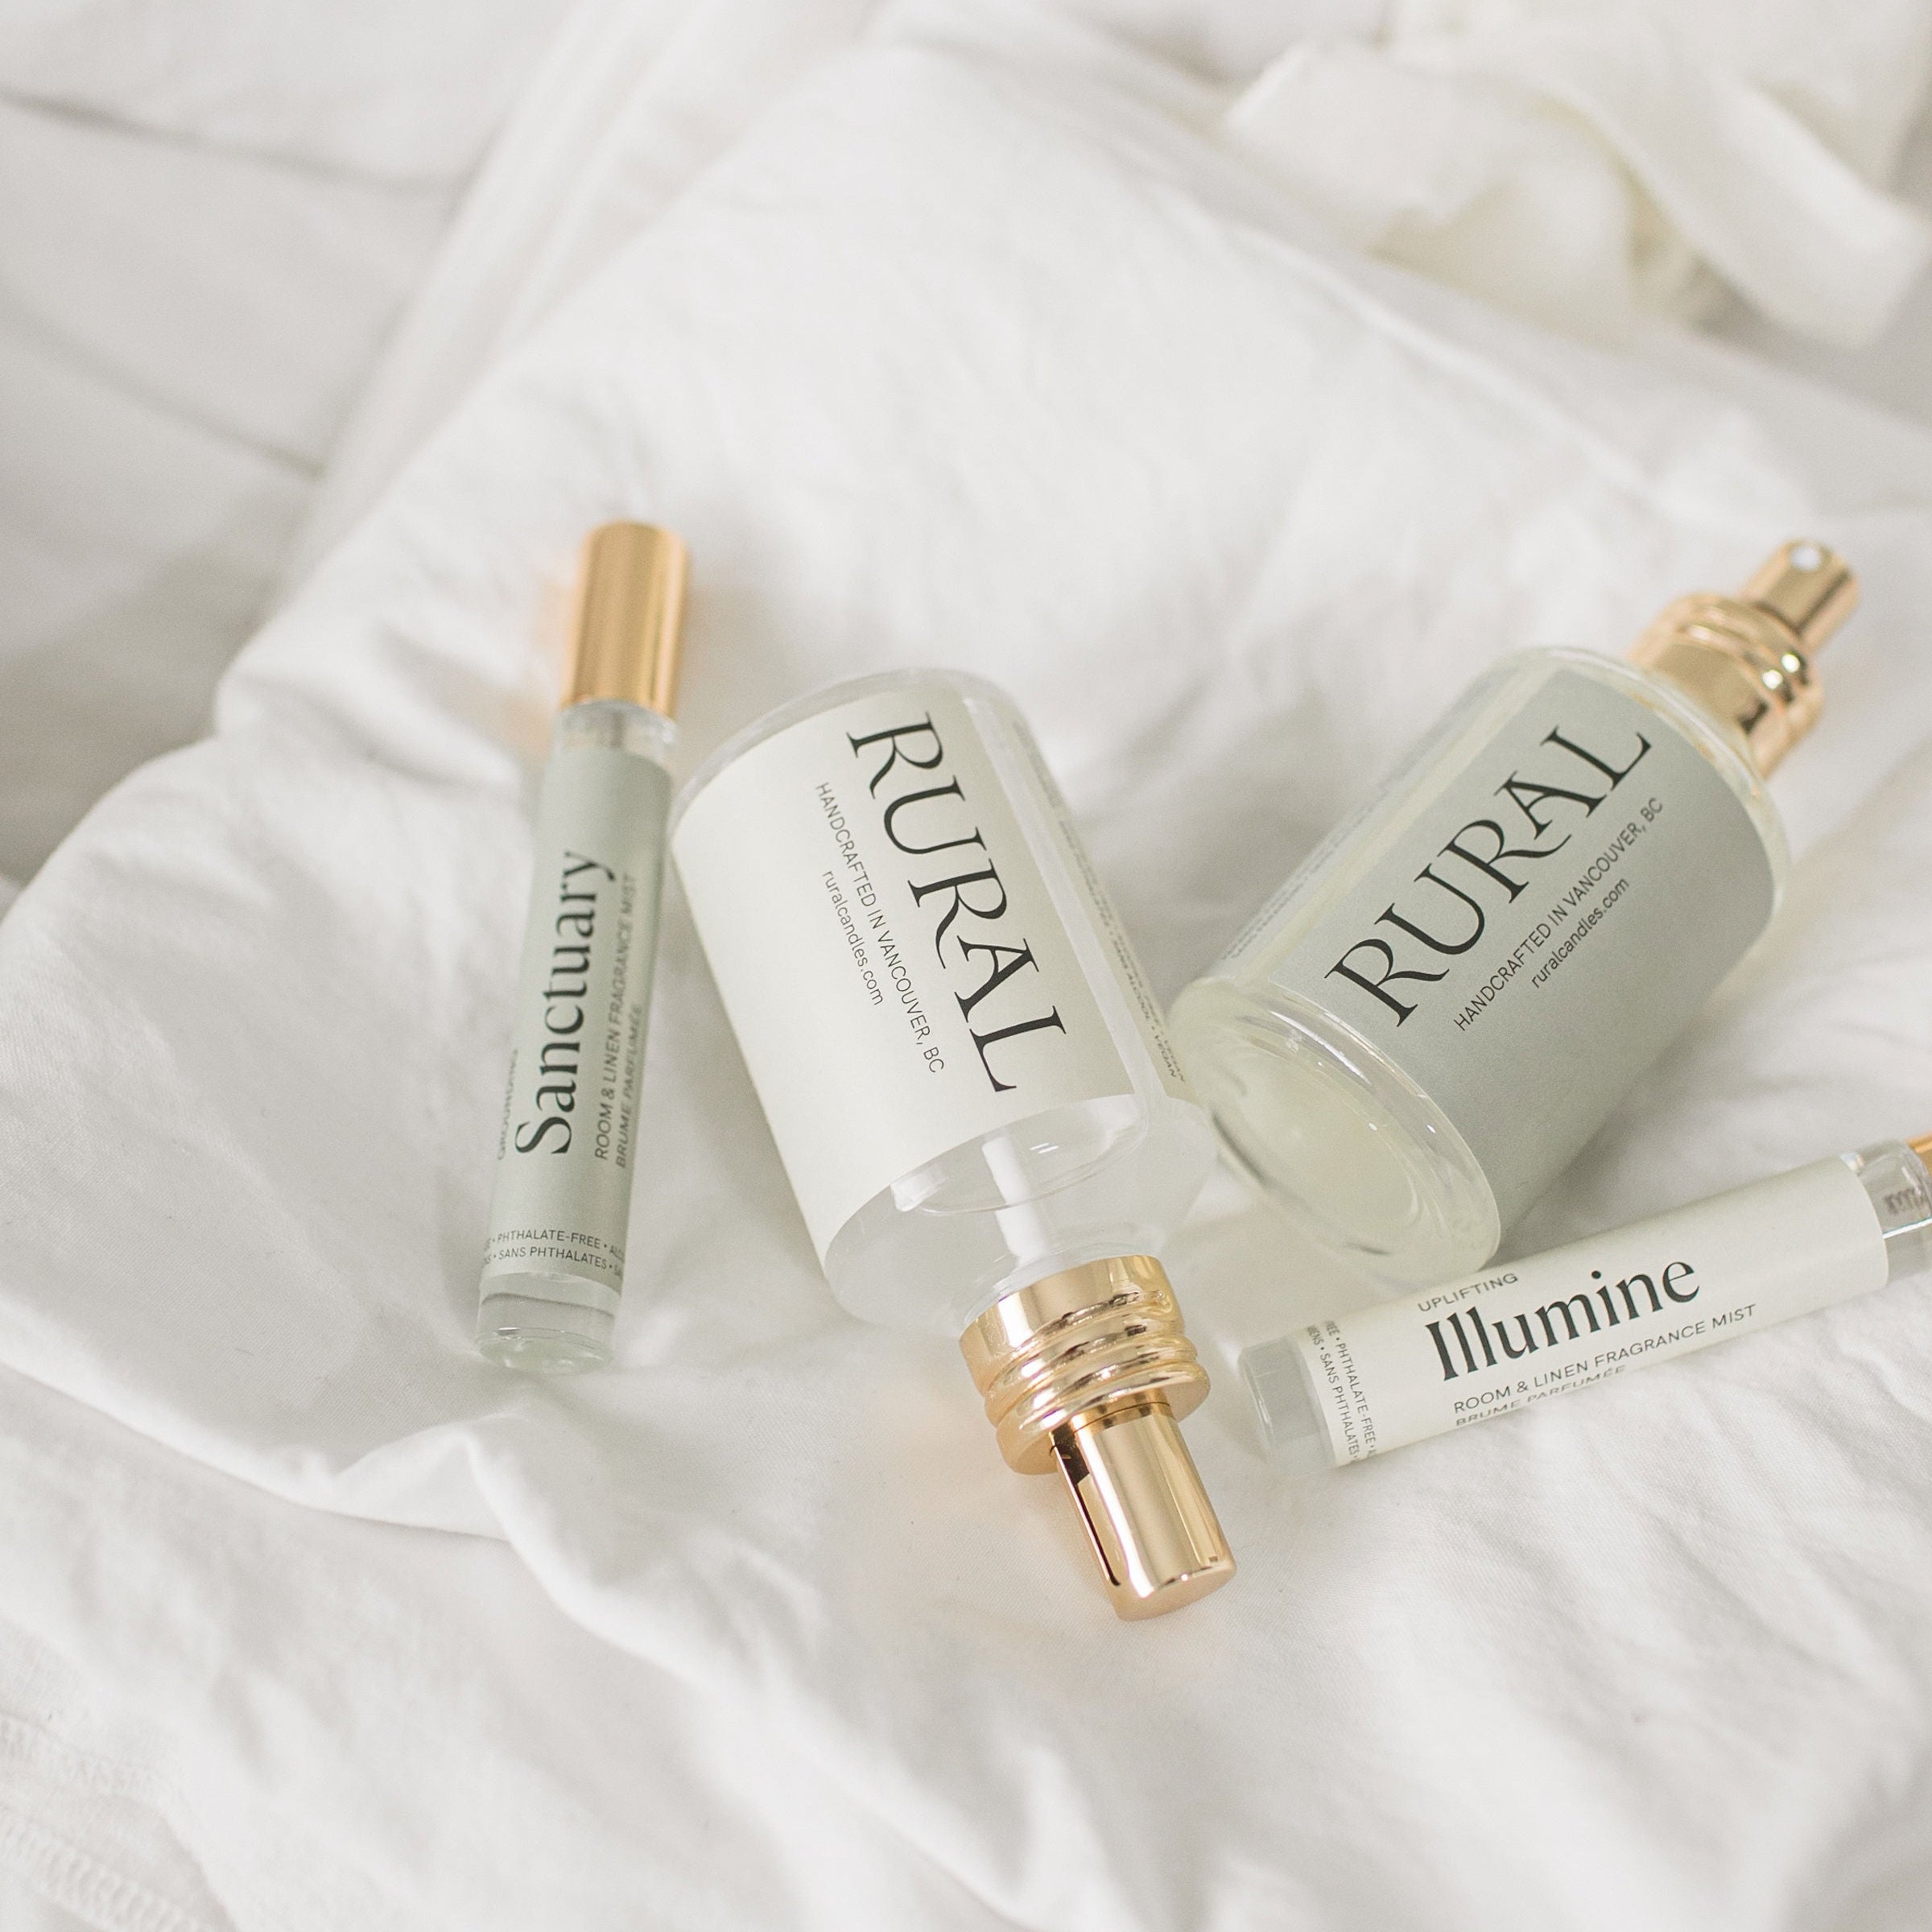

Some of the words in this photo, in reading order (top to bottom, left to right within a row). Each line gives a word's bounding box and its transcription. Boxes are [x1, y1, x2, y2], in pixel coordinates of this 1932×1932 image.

[619, 873, 636, 914] MIST
[846, 712, 1066, 1092] RURAL
[1324, 726, 1651, 1026] RURAL
[1453, 923, 1552, 1031] HANDCRAFTED
[1547, 905, 1568, 927] IN
[1563, 821, 1646, 914] VANCOUVER,
[1640, 797, 1663, 823] BC
[609, 919, 632, 1023] FRAGRANCE
[815, 782, 877, 907] HANDCRAFTED
[867, 908, 886, 929] IN
[877, 931, 931, 1045] VANCOUVER,
[923, 1047, 944, 1073] BC
[823, 870, 882, 1005] ruralcandles.com
[1531, 877, 1629, 989] ruralcandles.com
[514, 850, 615, 1154] Sanctuary
[601, 1088, 615, 1100] &
[603, 1030, 621, 1084] LINEN
[595, 1103, 614, 1160] ROOM
[616, 1104, 632, 1167] BRUME
[497, 1229, 601, 1249] PHTHALATE-FREE
[499, 1247, 526, 1260] SANS
[530, 1246, 606, 1269] PHTHALATES
[1418, 1272, 1518, 1313] UPLIFTING
[1424, 1261, 1699, 1381] Illumine
[1320, 1353, 1340, 1384] SANS
[1332, 1386, 1360, 1455] PHTHALATES
[1335, 1343, 1376, 1443] PHTHALATE-FREE
[1454, 1385, 1511, 1414] ROOM
[1517, 1380, 1528, 1393] &
[1534, 1360, 1588, 1388] LINEN
[1594, 1321, 1707, 1368] FRAGRANCE
[1712, 1303, 1756, 1328] MIST
[1455, 1399, 1520, 1426] BRUME
